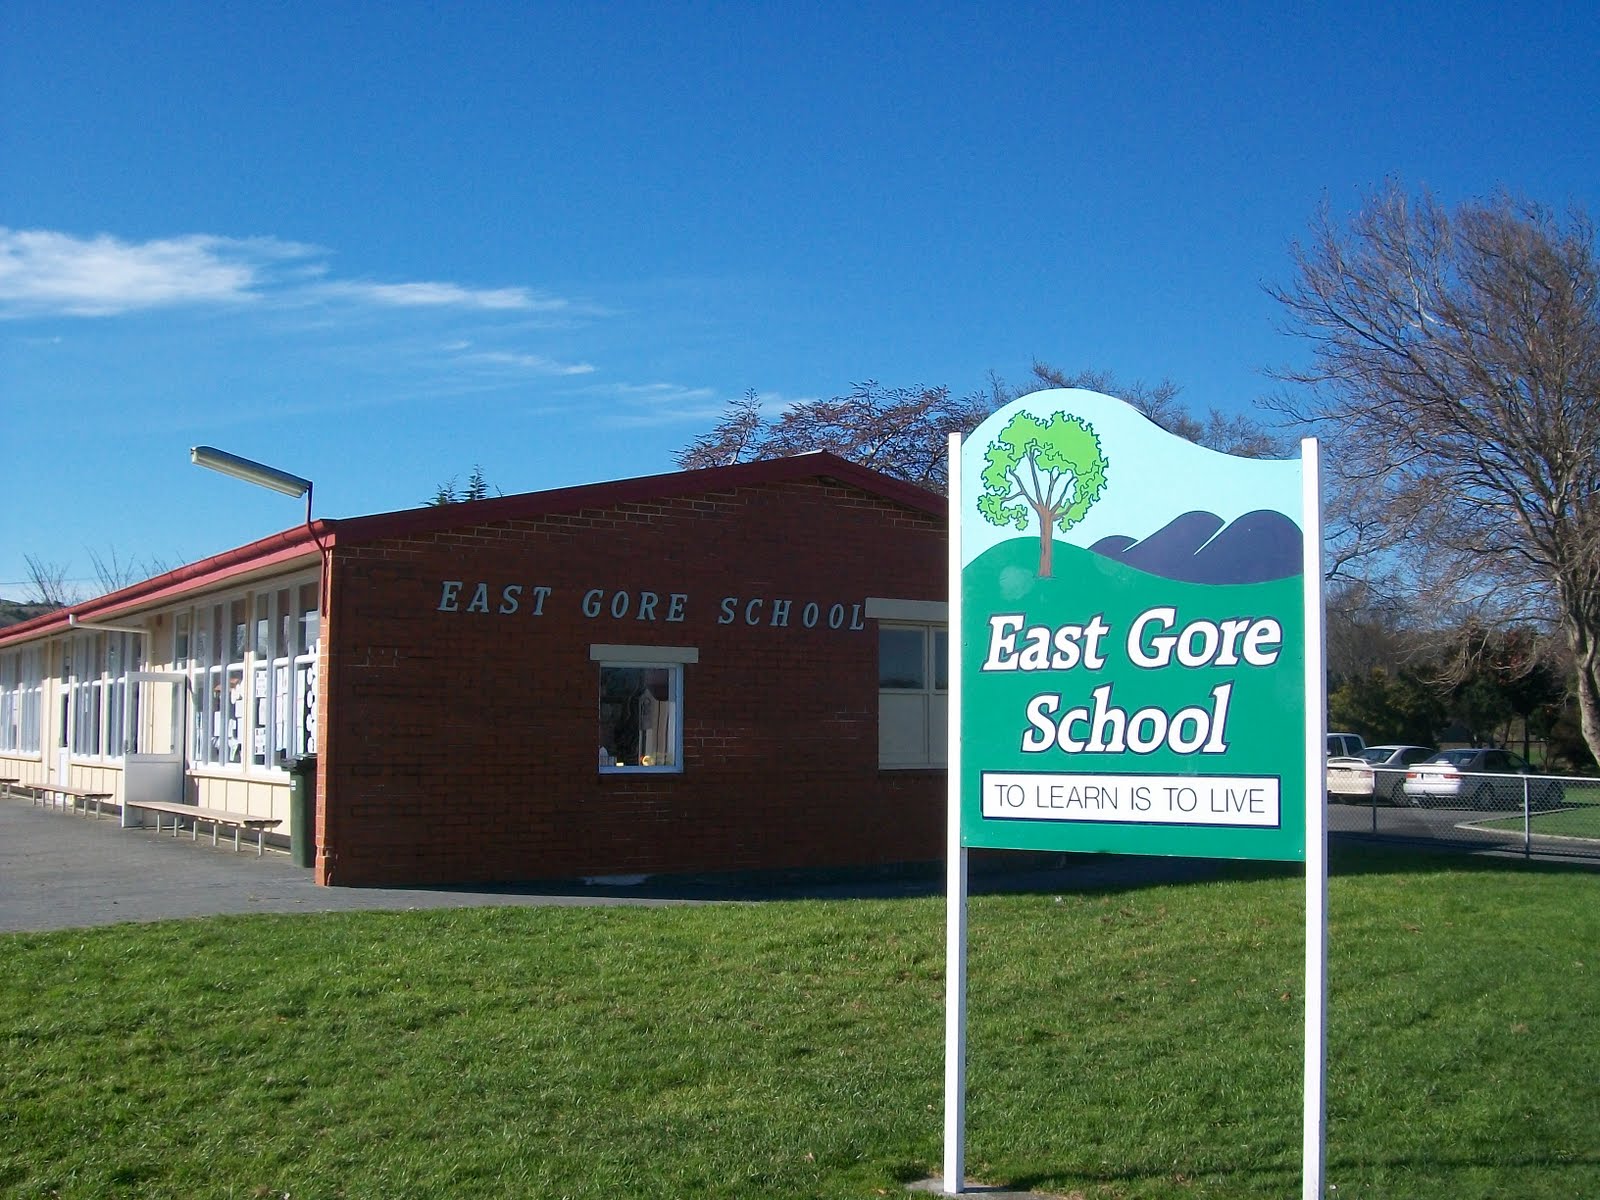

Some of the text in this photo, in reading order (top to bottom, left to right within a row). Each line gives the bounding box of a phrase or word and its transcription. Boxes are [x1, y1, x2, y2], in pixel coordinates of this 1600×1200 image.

[437, 580, 866, 631] EAST GORE SCHOOL
[980, 606, 1283, 672] East Gore
[1020, 680, 1235, 755] School
[994, 784, 1265, 813] TO LEARN IS TO LIVE
